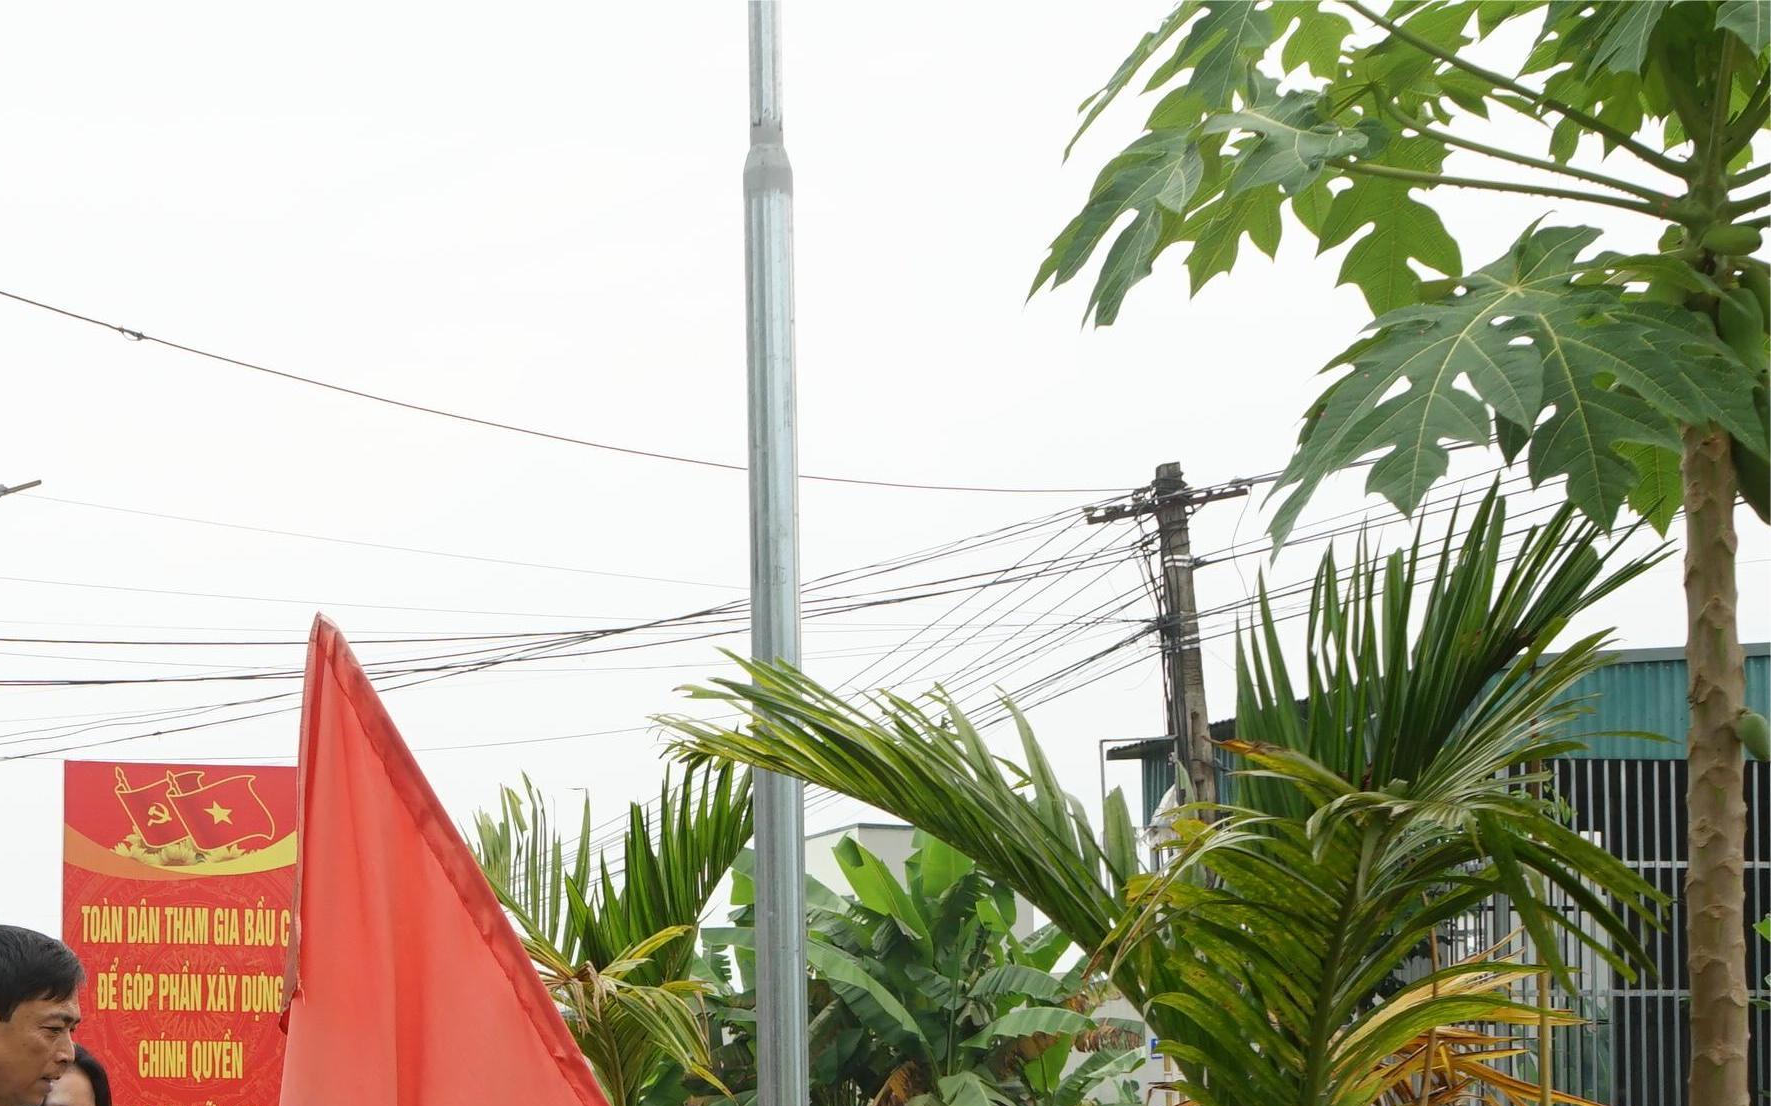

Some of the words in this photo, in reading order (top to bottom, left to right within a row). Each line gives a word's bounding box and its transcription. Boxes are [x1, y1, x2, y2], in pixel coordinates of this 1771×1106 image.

[81, 898, 123, 944] TOÀN
[128, 898, 160, 944] DÂN
[164, 907, 209, 945] THAM
[214, 908, 240, 946] GIA
[244, 896, 276, 947] BẦU
[280, 909, 291, 947] C
[97, 957, 119, 1010] ĐỂ
[123, 965, 154, 1011] GÓP
[158, 960, 201, 1011] PHẦN
[206, 966, 237, 1012] XÂY
[242, 971, 284, 1021] DỰNG
[138, 1032, 187, 1078] CHÍNH
[191, 1029, 243, 1082] QUYỀN
